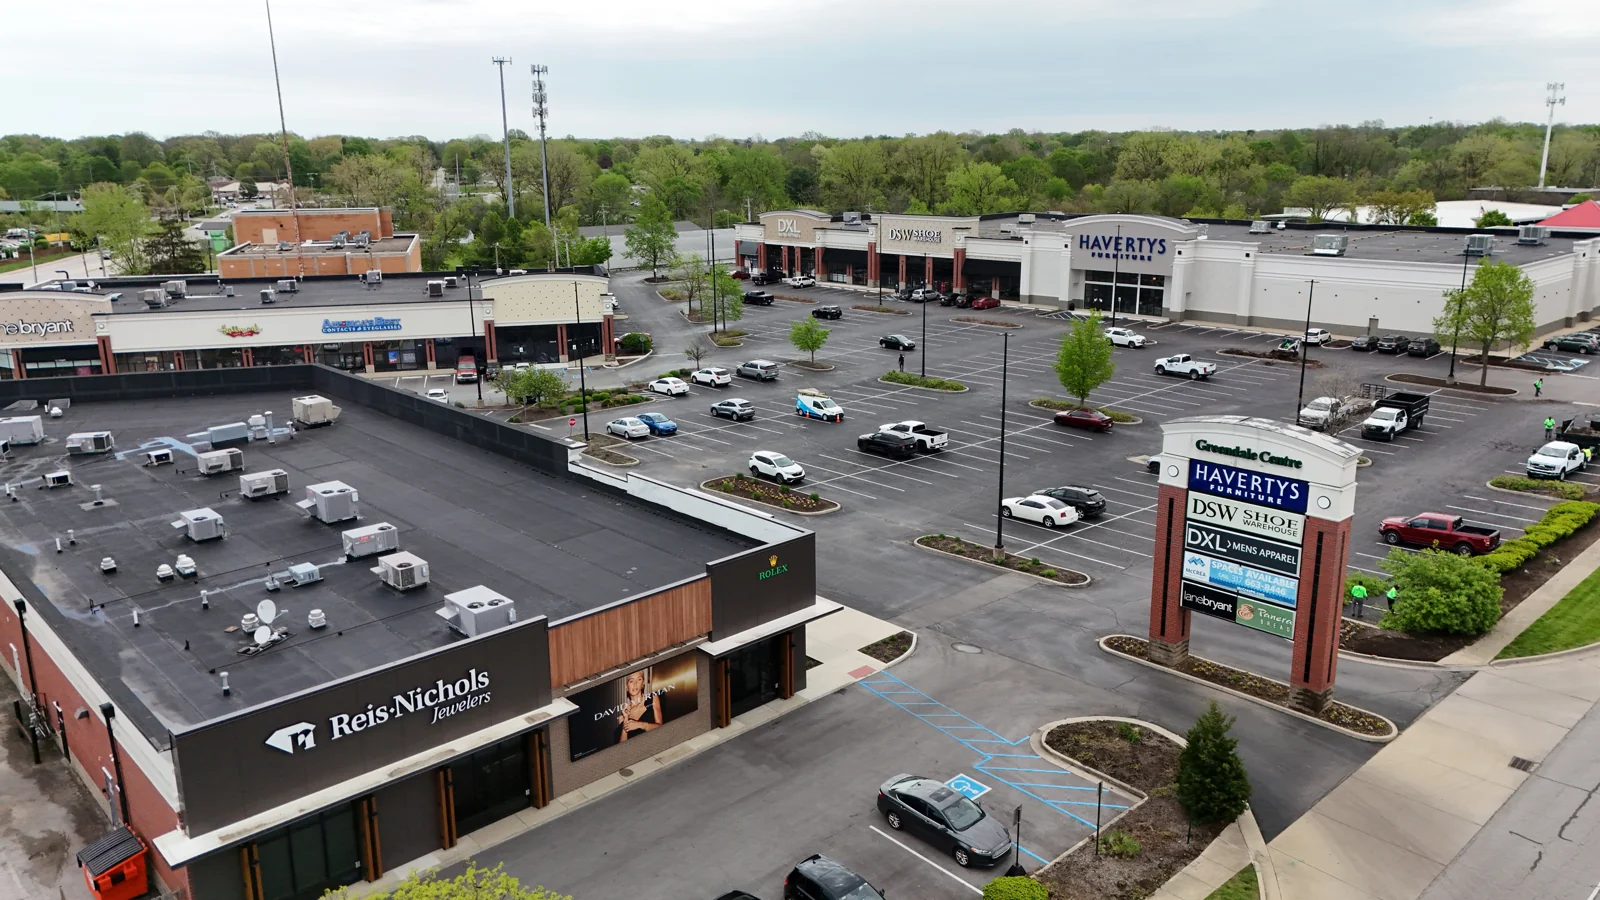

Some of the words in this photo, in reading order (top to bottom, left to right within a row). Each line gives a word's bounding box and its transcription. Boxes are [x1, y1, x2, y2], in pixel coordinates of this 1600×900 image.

[778, 219, 801, 233] DXL
[889, 229, 913, 241] DSW
[913, 230, 941, 238] SHOE
[1079, 235, 1166, 255] HAVERTYS
[1091, 252, 1152, 261] FURNITURE
[1195, 439, 1258, 461] Greendale
[1259, 451, 1303, 469] Centre
[1195, 464, 1300, 499] HAVERTYS
[1210, 484, 1282, 505] FURNITURE
[1192, 498, 1239, 522] DSW
[1243, 509, 1299, 531] SHOE
[1242, 519, 1298, 537] WAREHOUSE
[1187, 528, 1227, 552] DXL
[1232, 541, 1258, 555] MENS
[1259, 549, 1296, 565] APPAREL
[759, 564, 788, 580] ROLEX
[1211, 560, 1243, 575] SPACES
[1245, 570, 1295, 589] AVAILABLE
[1244, 579, 1287, 595] 663-8446
[1258, 608, 1293, 626] Panera
[1260, 619, 1291, 633] BREAD
[431, 691, 491, 724] Jewelers
[594, 703, 629, 721] DAVID
